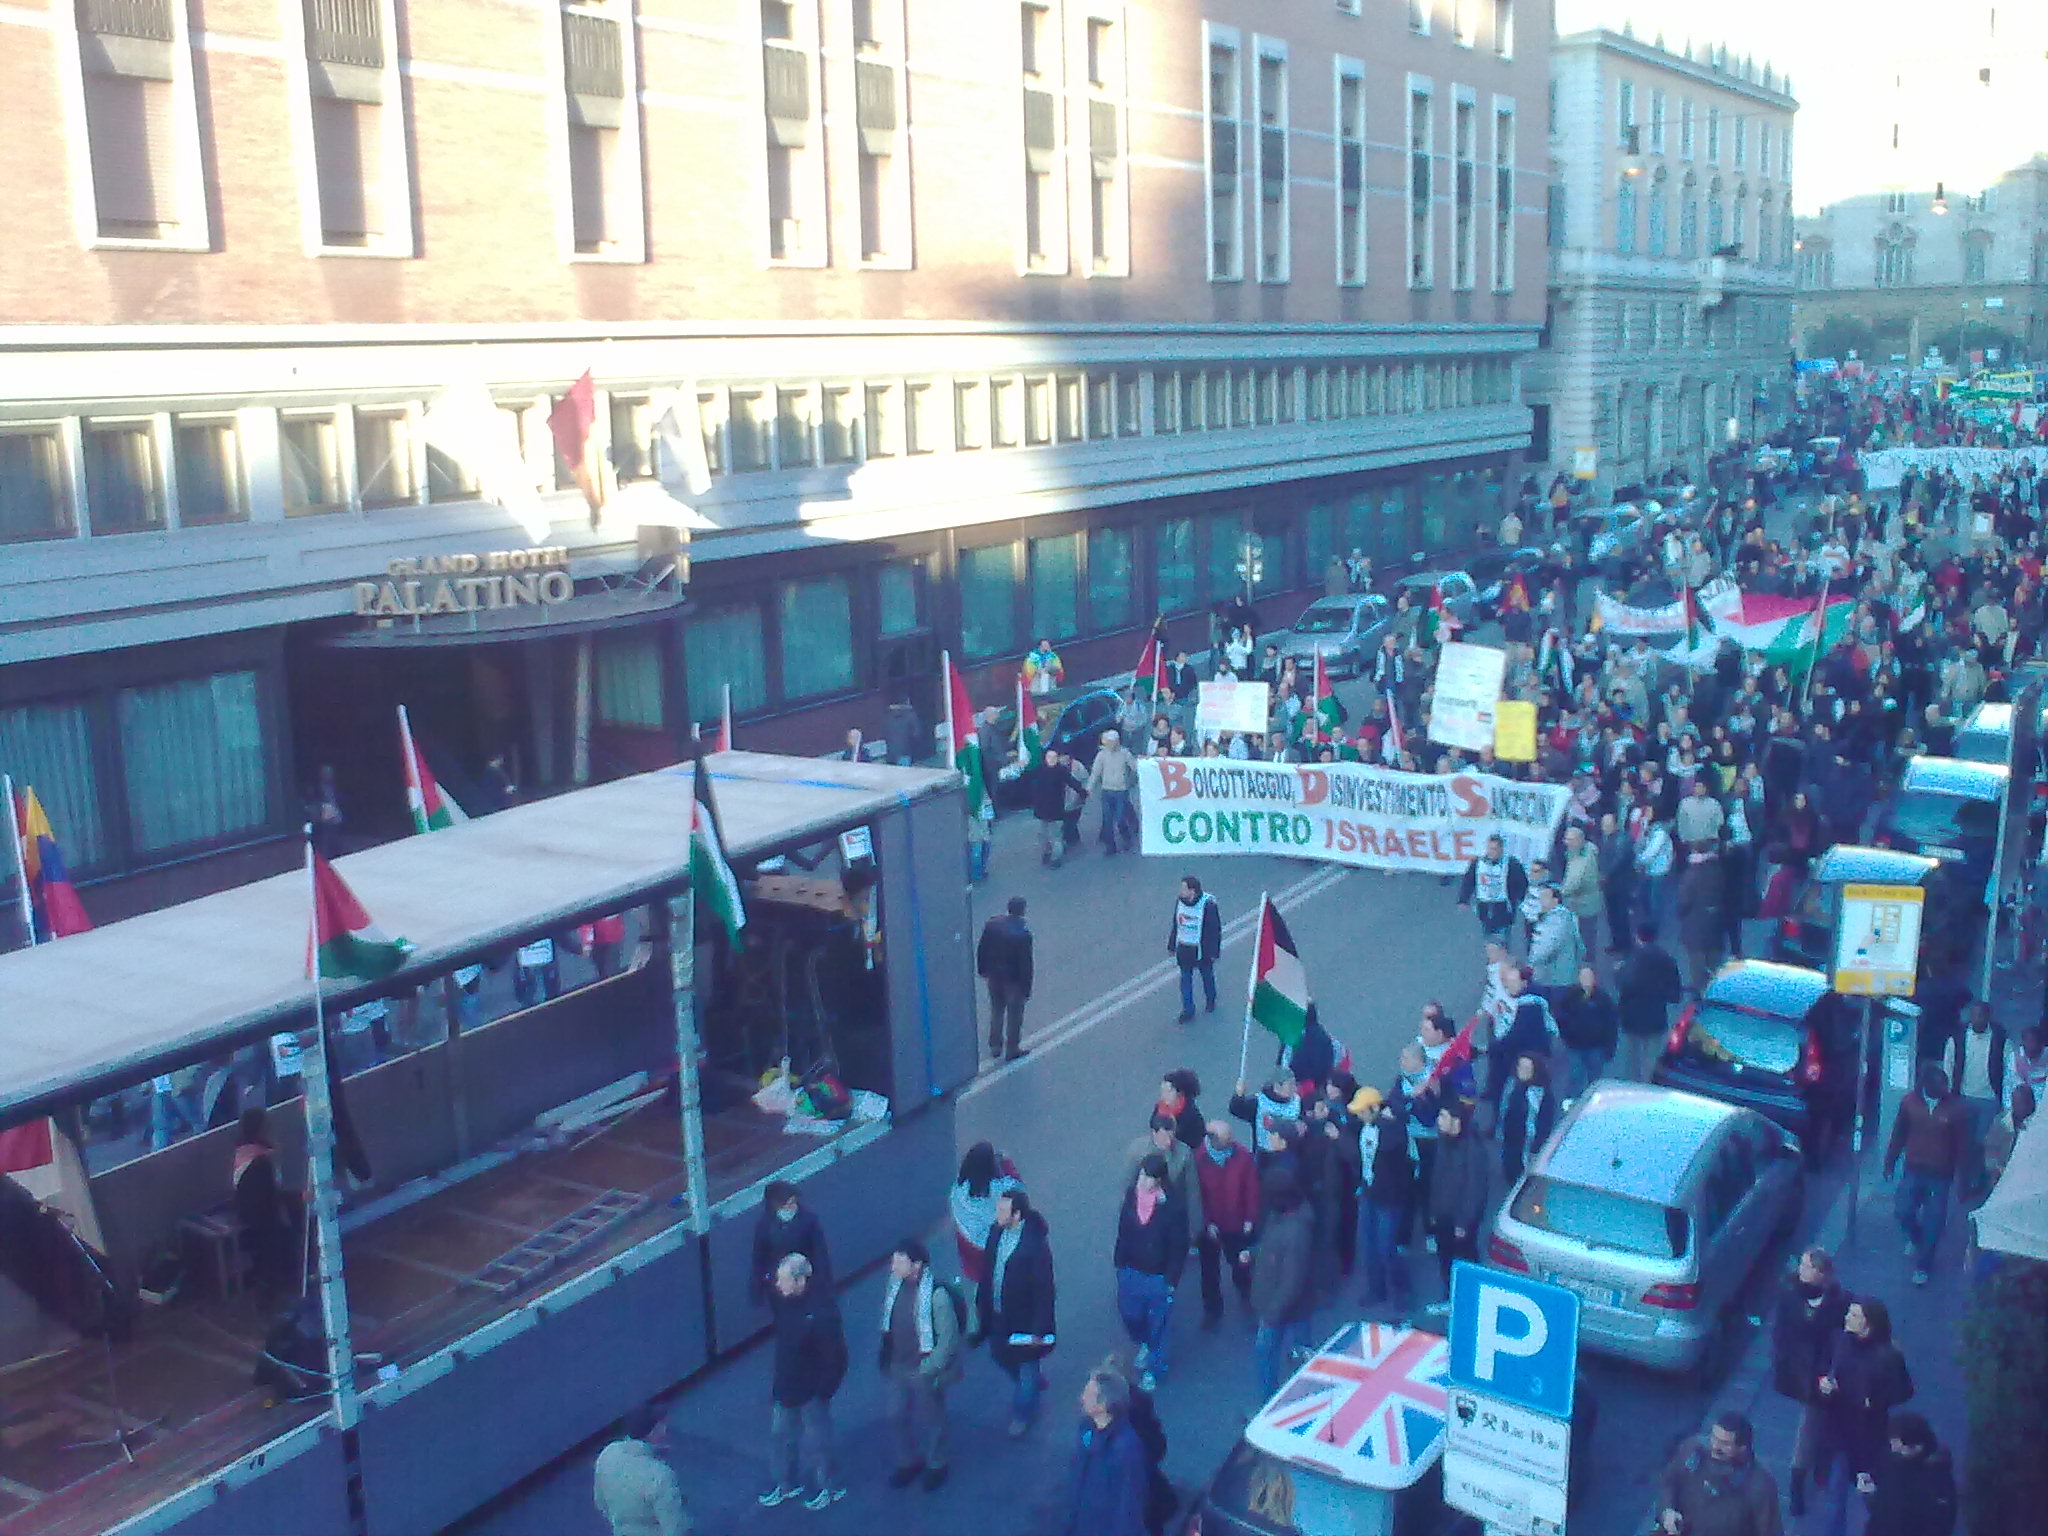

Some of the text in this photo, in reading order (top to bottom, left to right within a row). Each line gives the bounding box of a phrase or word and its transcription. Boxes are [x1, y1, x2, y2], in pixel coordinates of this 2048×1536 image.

[387, 546, 568, 575] GRAND HOTEL
[354, 571, 574, 615] PALATINO
[1162, 811, 1477, 861] CONTRO ISRAELE
[1474, 1284, 1549, 1381] P
